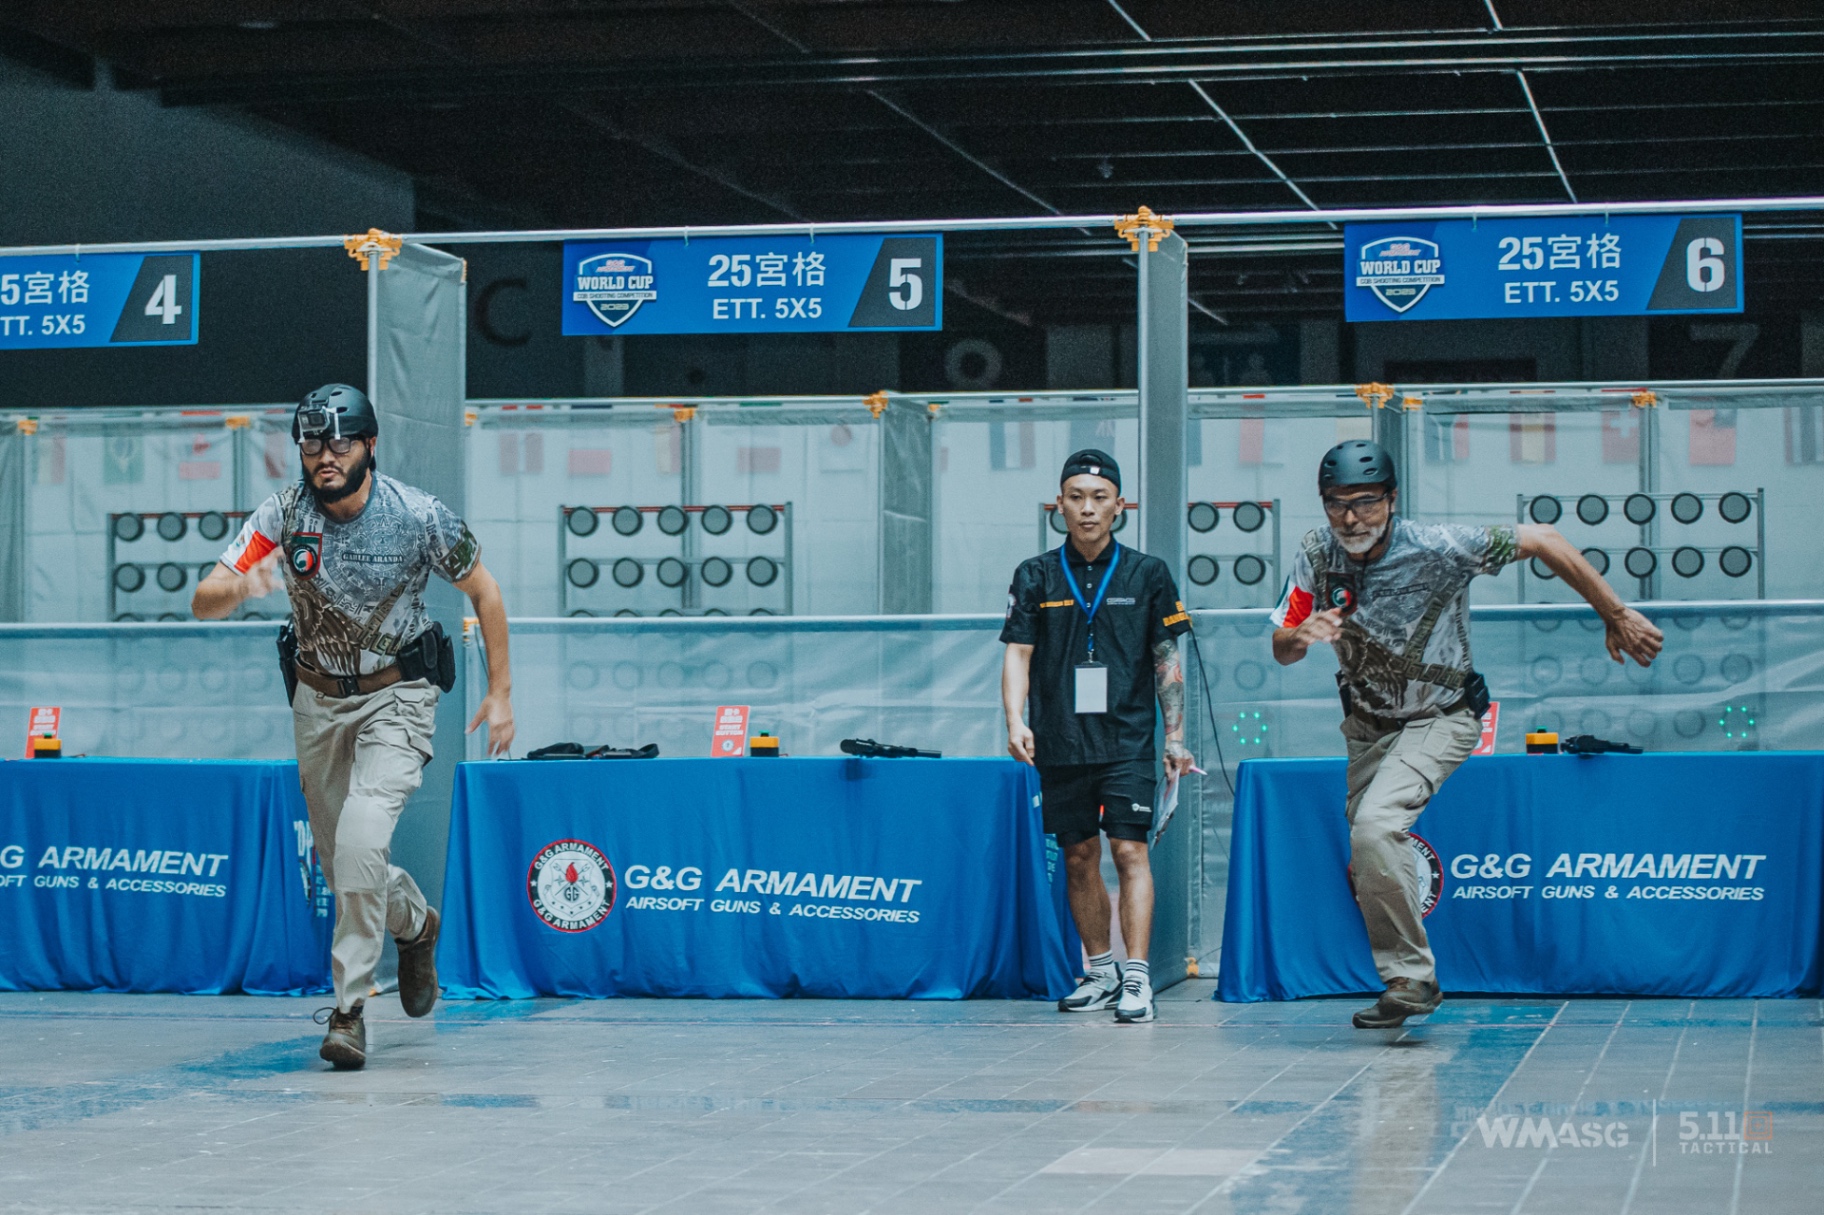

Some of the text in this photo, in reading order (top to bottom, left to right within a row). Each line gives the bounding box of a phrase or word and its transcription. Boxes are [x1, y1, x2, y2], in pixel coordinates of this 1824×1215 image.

[1499, 233, 1621, 270] 25宮格
[1688, 238, 1725, 292] 6
[708, 252, 825, 287] 25宮格
[1360, 260, 1441, 275] WORLD CUP
[577, 276, 654, 291] WORLD CUP
[889, 258, 922, 310] 5
[1505, 280, 1618, 303] ETT. 5X5
[145, 275, 181, 324] 4
[713, 298, 821, 319] ETT. 5X5
[42, 315, 85, 335] 5X5
[38, 846, 228, 876] ARMAMENT
[534, 842, 610, 871] G&G ARMAMENT
[1451, 853, 1766, 879] G&G ARMAMENT
[34, 876, 79, 888] GUNS
[88, 877, 98, 888] &
[106, 879, 226, 897] ACCESSORIES
[625, 865, 922, 903] G&G ARMAMENT
[1453, 886, 1764, 900] AIRSOFT GUNS & ACCESSORIES
[533, 899, 610, 930] G&G ARMAMENT
[626, 897, 920, 923] AIRSOFT GUNS & ACCESSORIES
